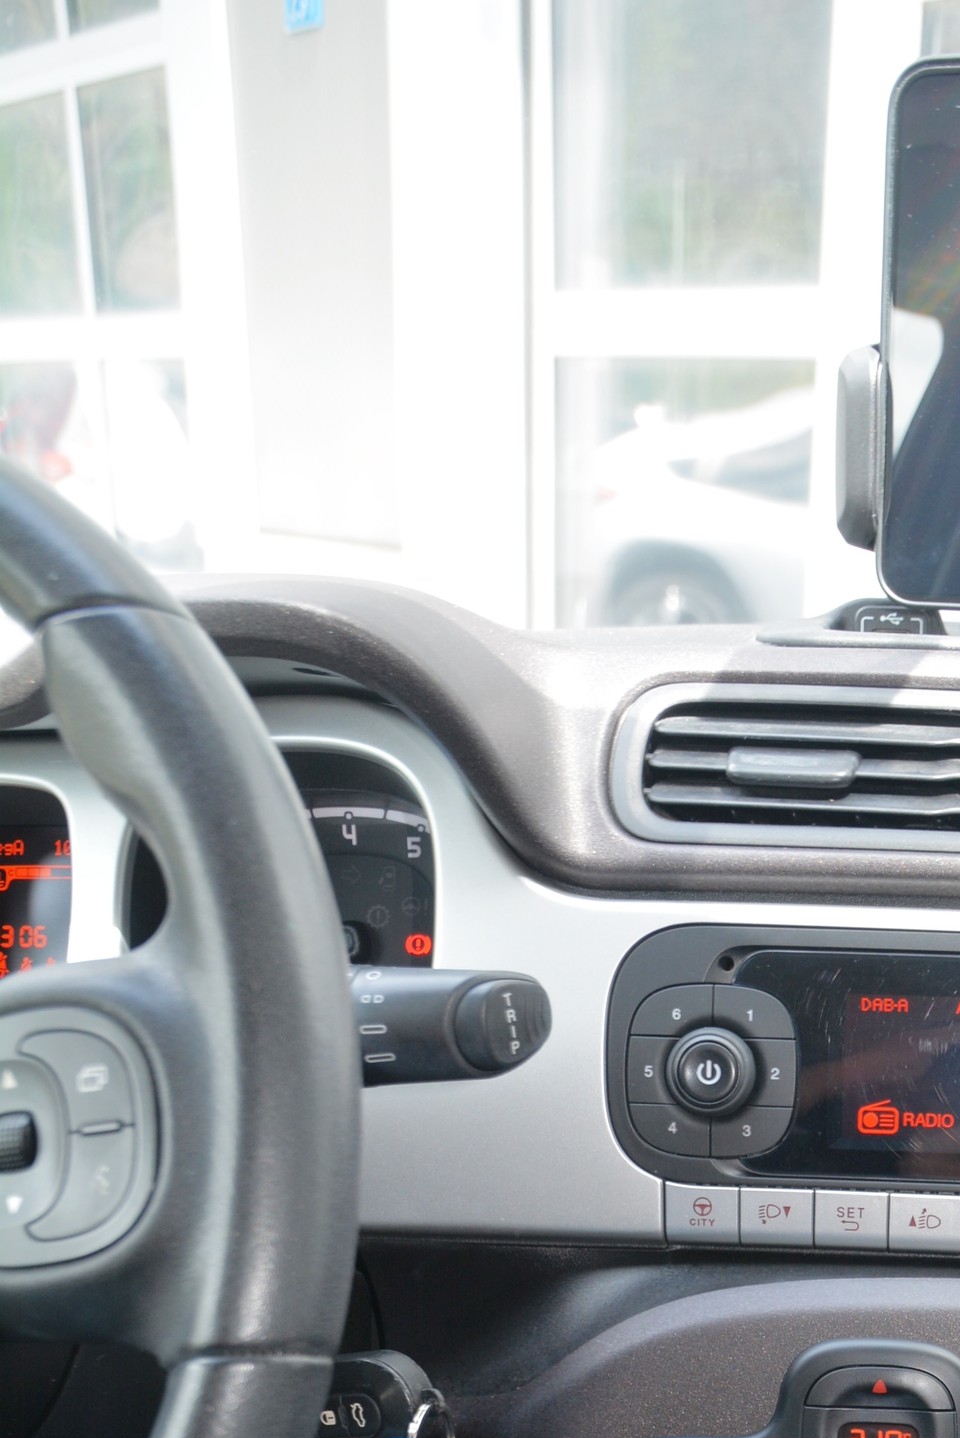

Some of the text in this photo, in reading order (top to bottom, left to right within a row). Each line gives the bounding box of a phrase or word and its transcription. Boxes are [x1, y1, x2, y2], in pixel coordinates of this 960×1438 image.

[341, 824, 358, 846] 4
[406, 836, 421, 859] 5
[671, 1008, 682, 1020] 6
[746, 1009, 754, 1022] 1
[502, 992, 521, 1055] TRIP
[643, 1064, 654, 1077] 5
[770, 1067, 781, 1080] 2
[902, 1112, 955, 1128] RADIO
[667, 1121, 678, 1134] 4
[742, 1124, 752, 1137] 3
[836, 1206, 866, 1219] SET
[689, 1218, 716, 1227] CITY
